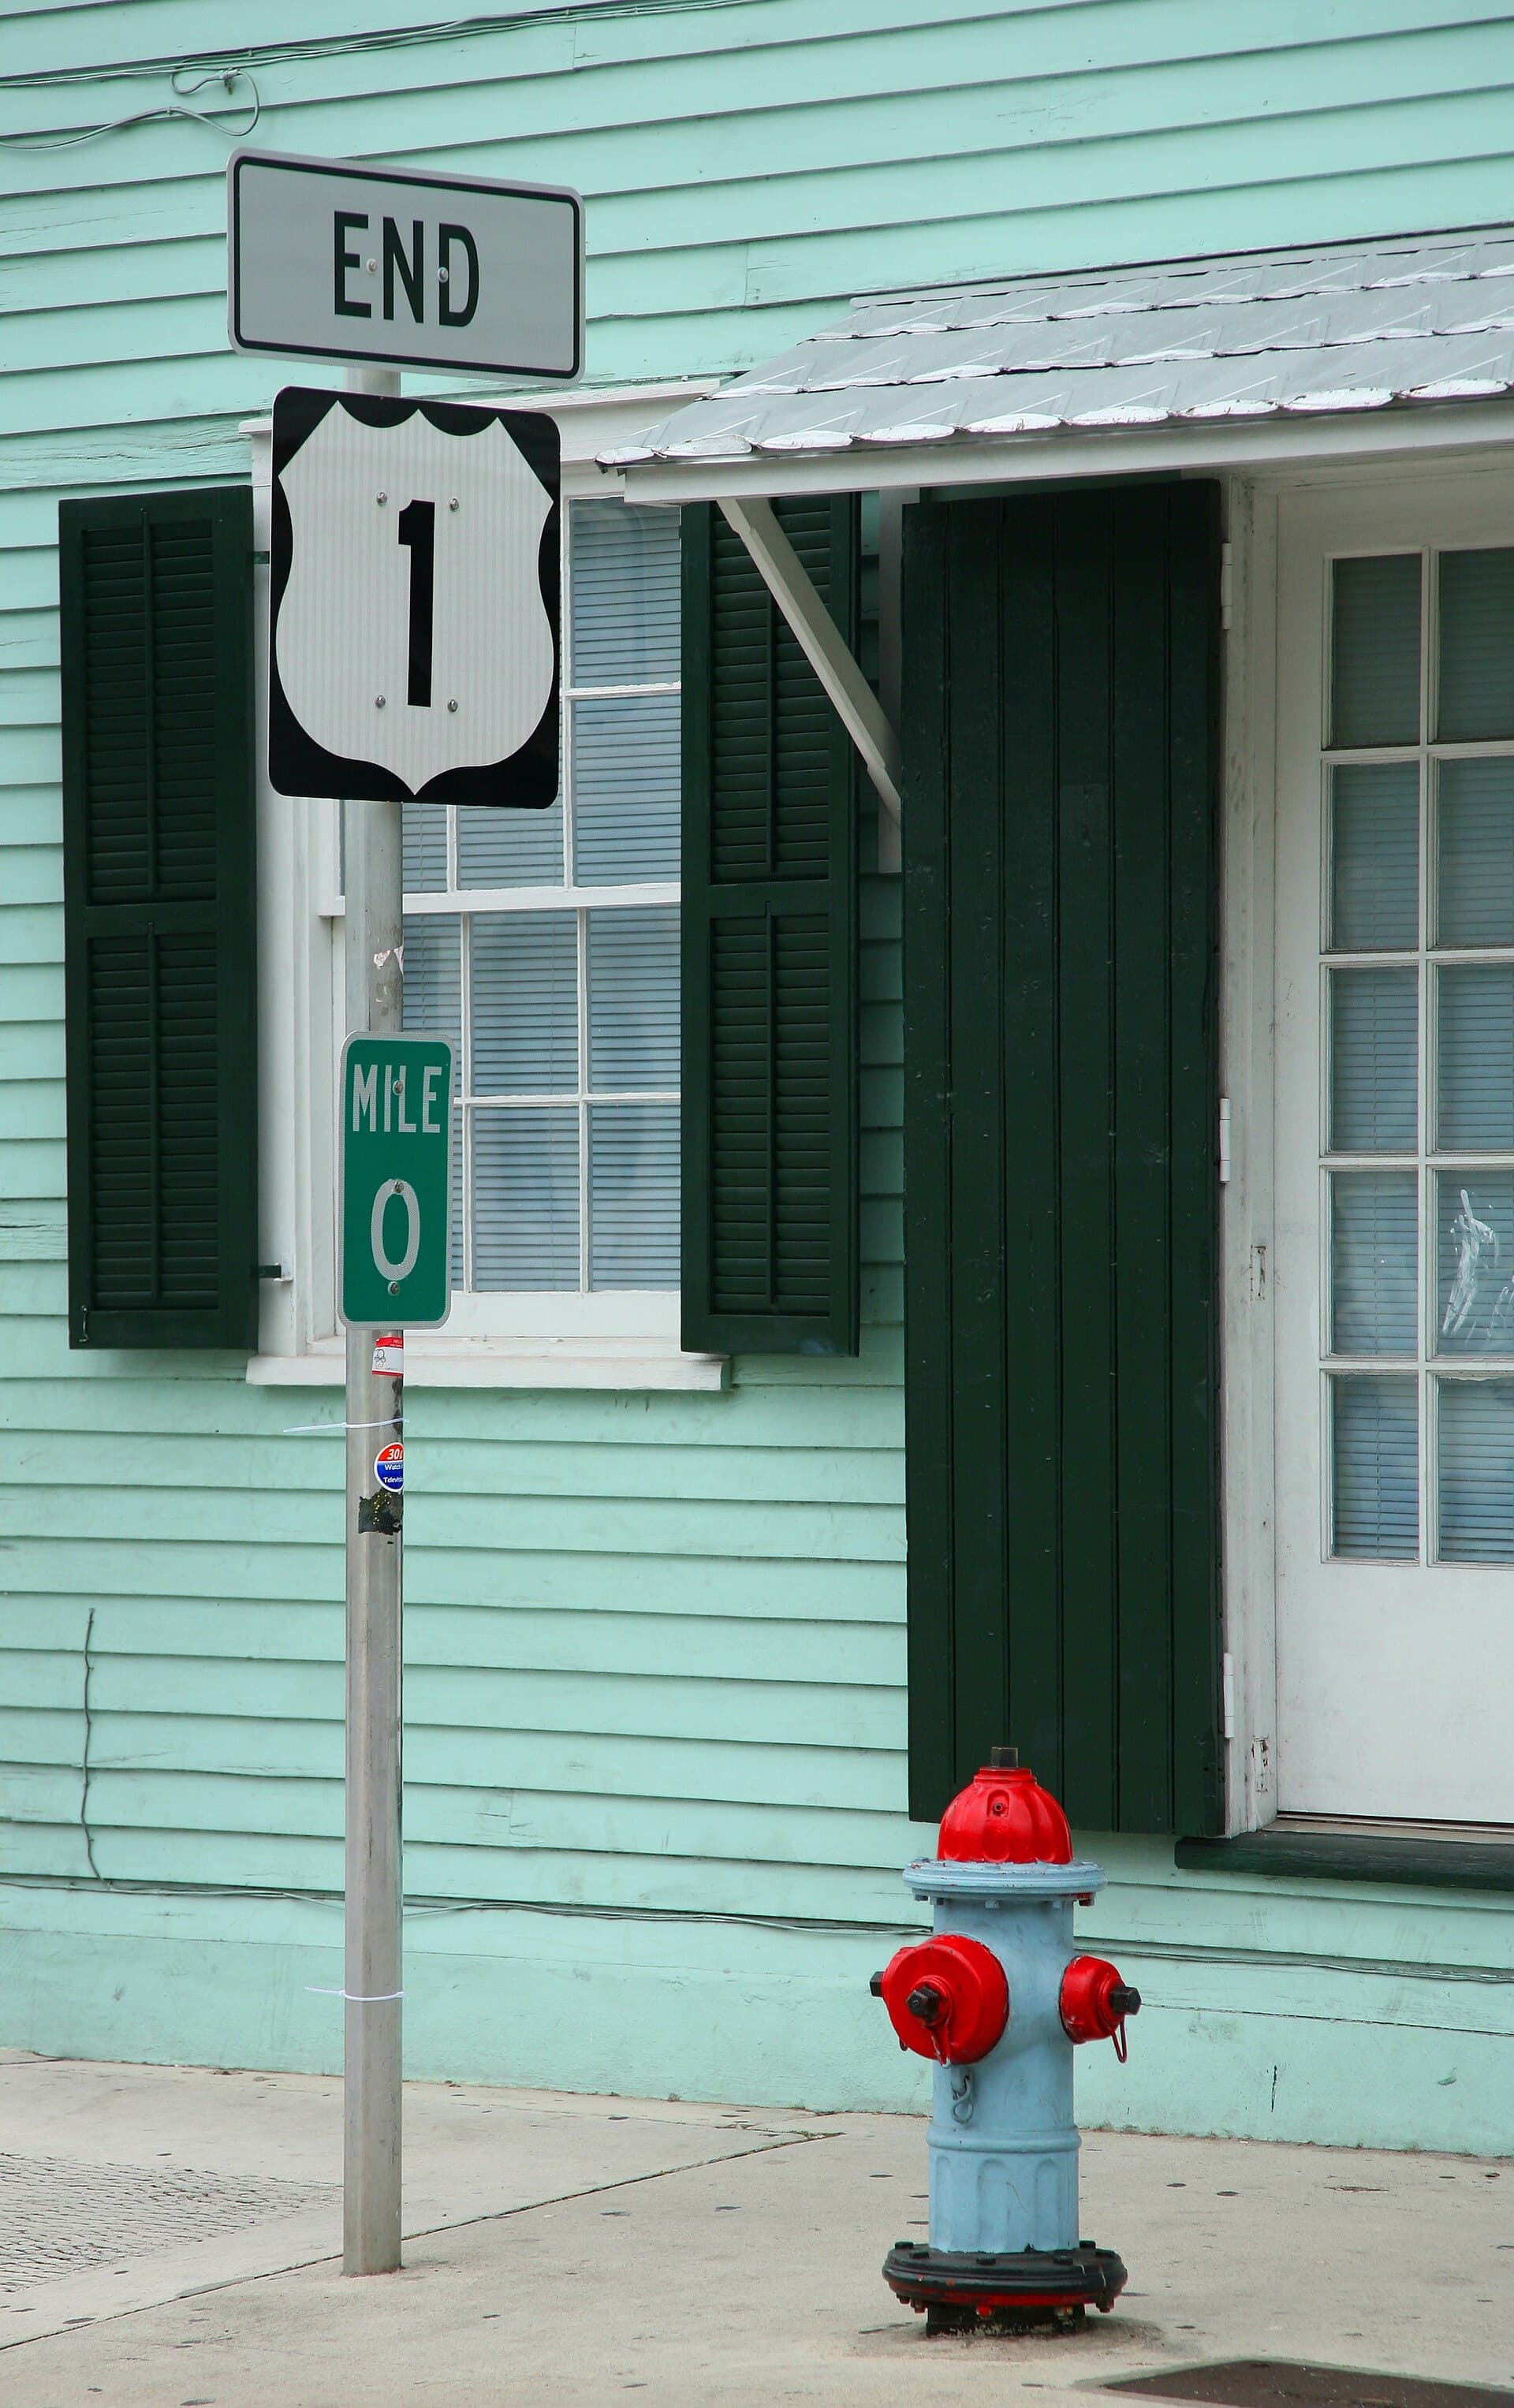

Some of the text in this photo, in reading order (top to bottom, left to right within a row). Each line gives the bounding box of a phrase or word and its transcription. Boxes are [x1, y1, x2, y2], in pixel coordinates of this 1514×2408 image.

[334, 210, 480, 328] END
[397, 498, 436, 709] 1
[352, 1063, 443, 1134] MILE
[371, 1178, 420, 1281] 0
